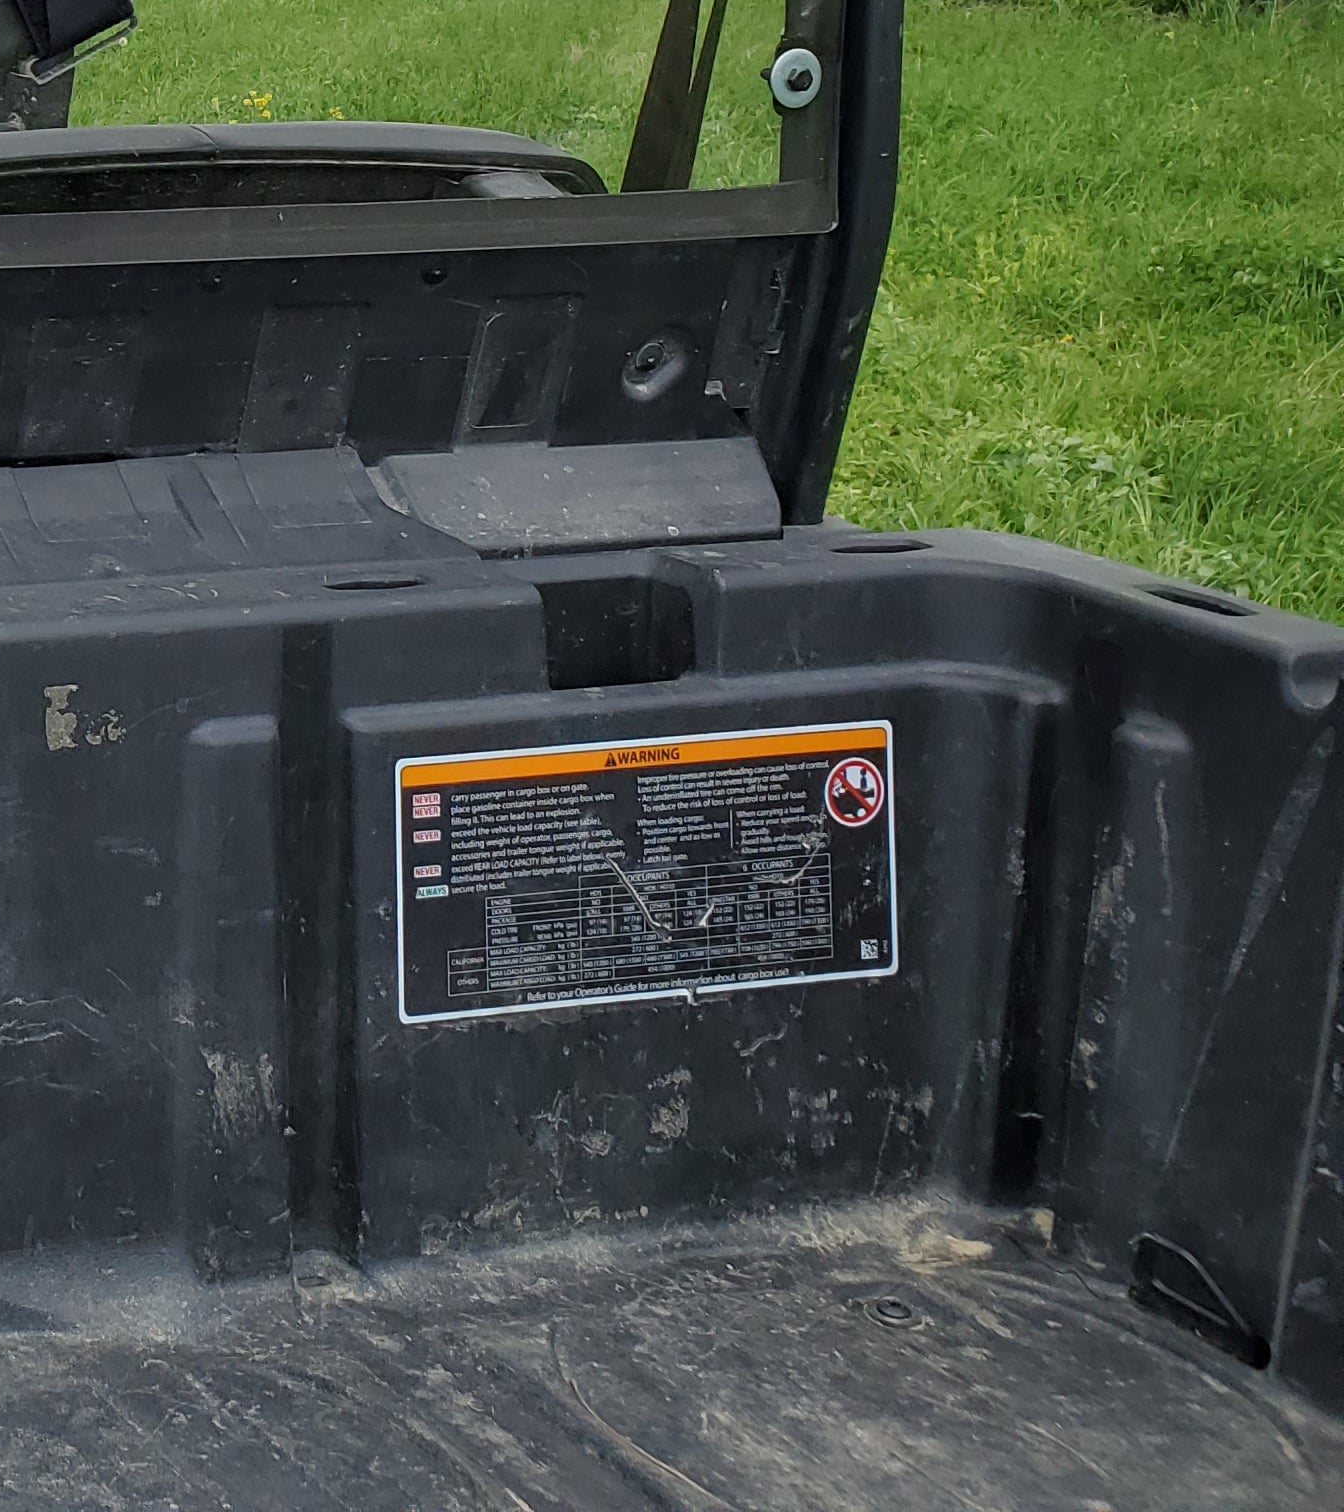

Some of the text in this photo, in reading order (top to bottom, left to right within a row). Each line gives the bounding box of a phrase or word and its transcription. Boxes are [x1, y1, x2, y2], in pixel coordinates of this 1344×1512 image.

[617, 747, 679, 764] WARNING
[637, 773, 667, 785] Improper
[679, 771, 707, 781] pressure
[715, 766, 753, 778] overloading
[753, 766, 765, 774] can
[766, 765, 784, 773] cause
[785, 762, 797, 771] loss
[637, 784, 652, 793] Loss
[660, 781, 682, 791] control
[696, 779, 713, 788] result
[745, 784, 755, 792] off
[414, 794, 438, 804] NEVER
[451, 793, 468, 803] carry
[469, 790, 506, 801] passenger
[515, 787, 535, 797] cargo
[537, 785, 550, 793] box
[415, 791, 614, 815] NEVER place gasoline container inside cargo box when
[642, 803, 651, 812] To
[652, 801, 675, 811] reduce
[677, 800, 688, 809] the
[689, 799, 701, 808] risk
[711, 797, 724, 806] loss
[733, 794, 757, 804] control
[768, 792, 780, 801] loss
[451, 816, 471, 827] filling
[480, 814, 494, 823] This
[495, 813, 508, 821] can
[509, 811, 525, 820] lead
[545, 806, 580, 817] explosion.
[736, 809, 755, 817] When
[756, 807, 783, 818] carrying
[637, 816, 682, 826] When loading
[669, 820, 728, 834] cargo front
[741, 817, 779, 826] Reduce your
[415, 818, 578, 840] NEVER exceed the vehicle load capacity (see
[451, 839, 484, 851] including
[486, 836, 510, 848] weight
[643, 836, 656, 844] and
[679, 833, 691, 841] and
[451, 850, 490, 861] accessories
[491, 848, 505, 857] and
[507, 846, 528, 855] trailer
[555, 842, 579, 853] weight
[416, 866, 439, 875] NEVER
[451, 863, 472, 872] exceed
[474, 862, 489, 870] REAR
[491, 860, 508, 869] LOAD
[509, 857, 539, 867] CAPACITY
[566, 853, 581, 862] label
[752, 859, 794, 871] OCCUPANTS
[451, 872, 483, 883] distributed
[627, 871, 669, 882] OCCUPANTS
[416, 881, 506, 897] ALWAYS secure the load.
[490, 898, 510, 906] ENGINE
[491, 907, 511, 915] DOORS
[452, 956, 484, 965] CALIFORNIA
[457, 977, 478, 986] OTHERS
[527, 990, 545, 1001] Refer
[557, 989, 573, 999] your
[575, 984, 612, 997] Operator's
[614, 981, 636, 992] Guide
[638, 980, 648, 990] for
[649, 980, 669, 989] more
[670, 974, 712, 987] information
[714, 972, 735, 982] about
[738, 971, 758, 981] cargo
[759, 968, 772, 978] box
